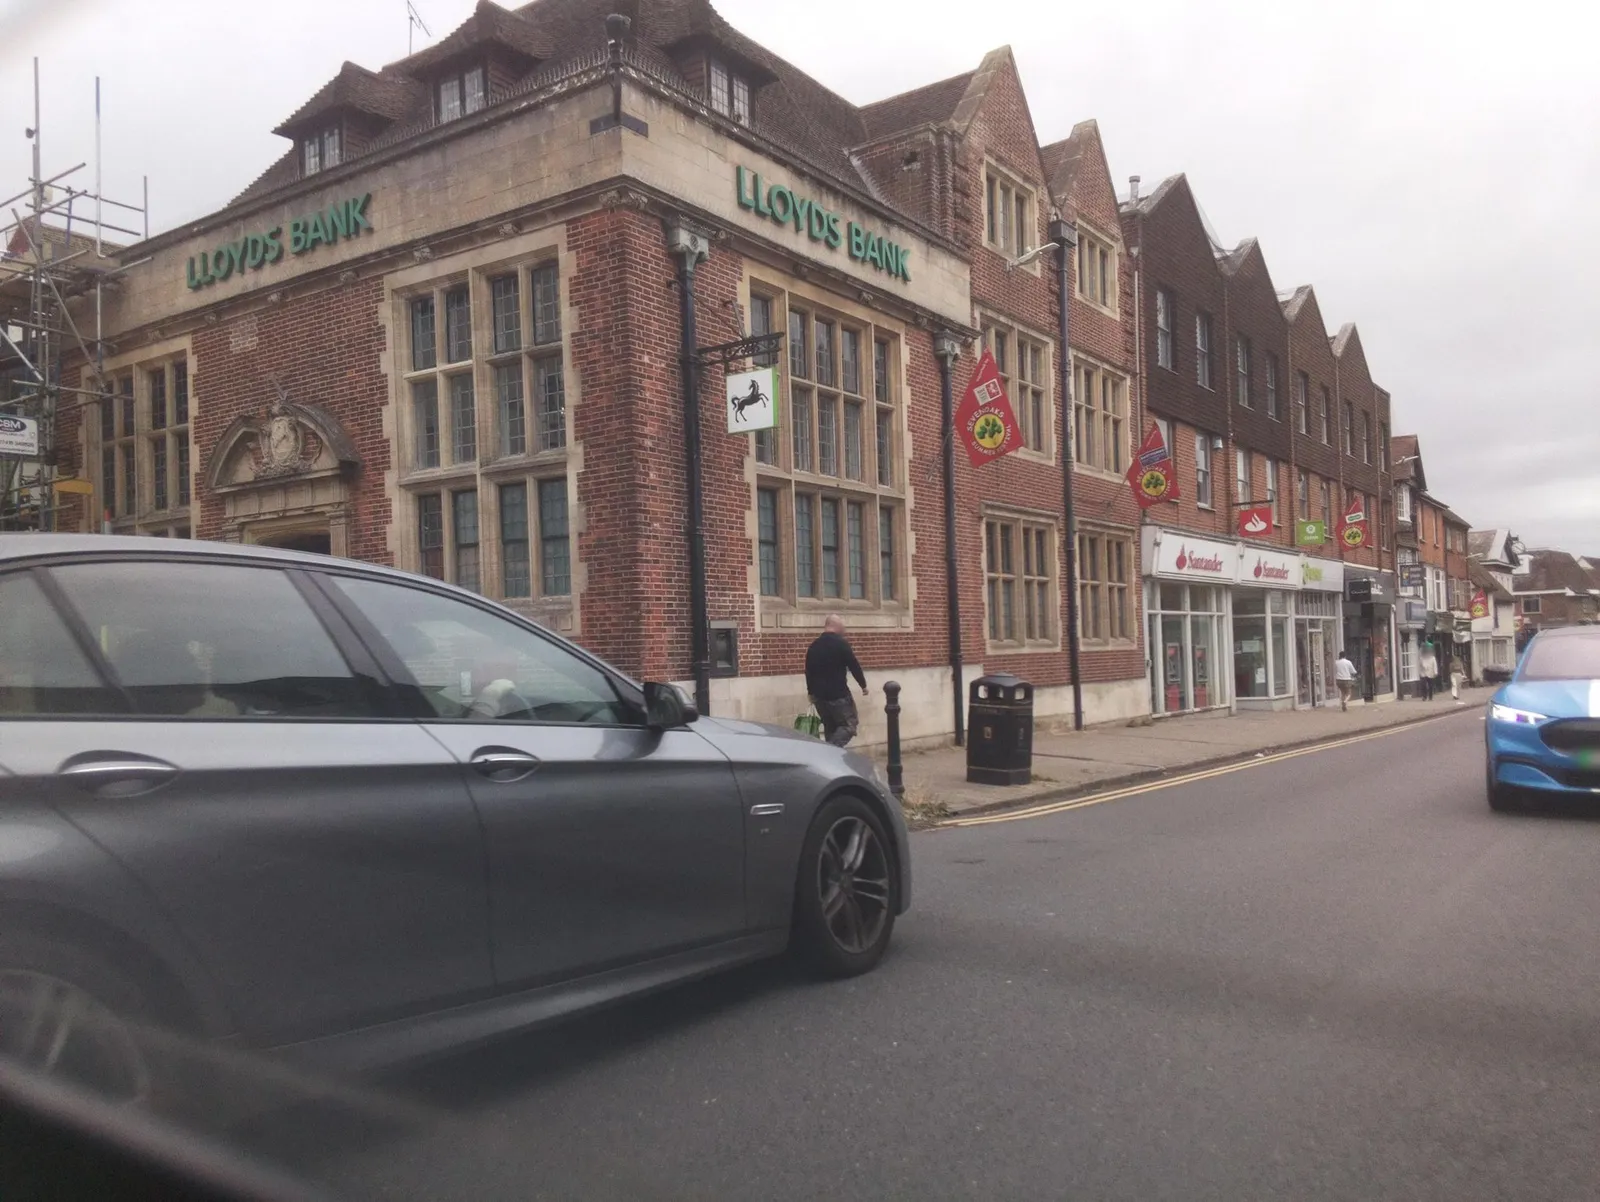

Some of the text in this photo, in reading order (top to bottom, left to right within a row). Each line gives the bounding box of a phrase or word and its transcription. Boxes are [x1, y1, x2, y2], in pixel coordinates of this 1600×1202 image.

[187, 193, 372, 290] LLOYDS BANK
[737, 165, 912, 281] LLOYDS BANK
[1188, 550, 1224, 573] Santander
[1263, 560, 1290, 580] Santander
